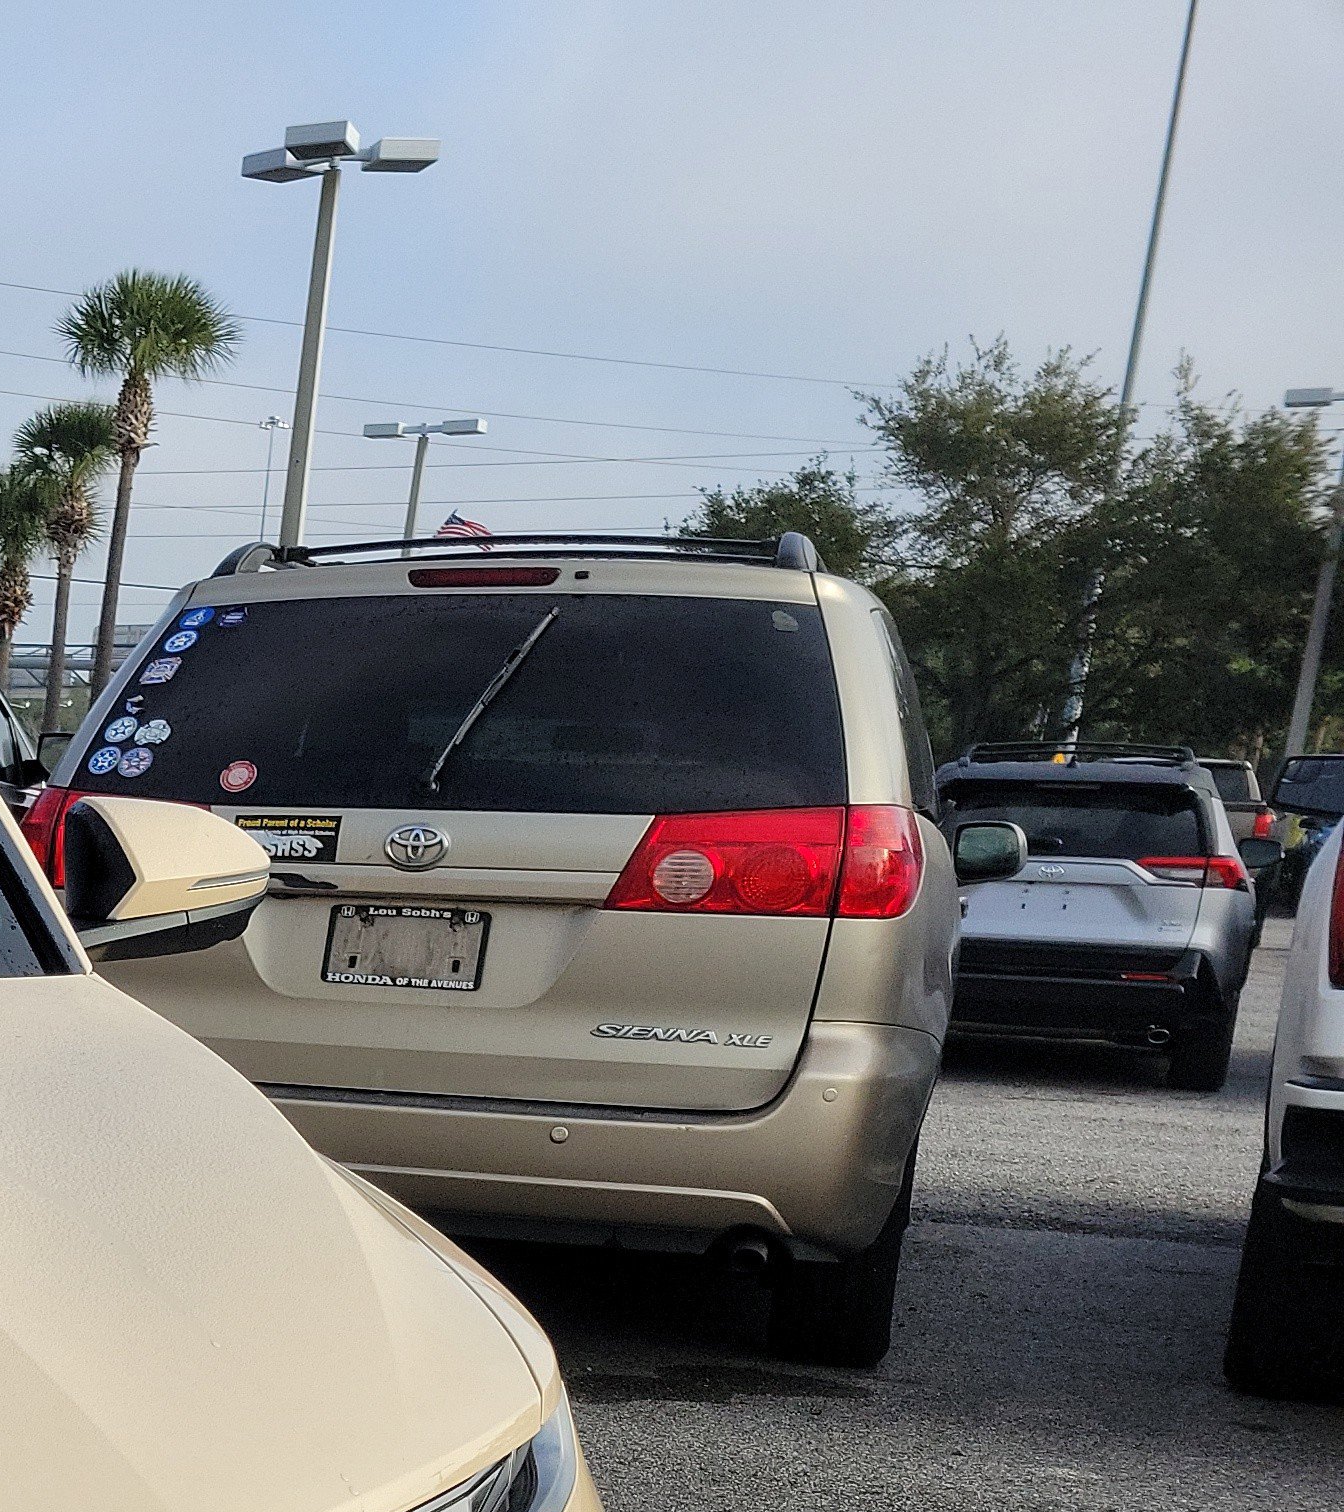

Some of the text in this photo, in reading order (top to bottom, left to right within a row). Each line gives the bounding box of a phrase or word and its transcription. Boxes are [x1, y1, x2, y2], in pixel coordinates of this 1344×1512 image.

[238, 819, 261, 827] Proud
[262, 819, 288, 827] Parent
[289, 819, 299, 827] of
[306, 819, 337, 828] Scholar
[368, 906, 452, 919] Lou Sobh's
[325, 972, 475, 990] HONDA OF THE AVENUES
[590, 1023, 773, 1048] SIENNA XLE
